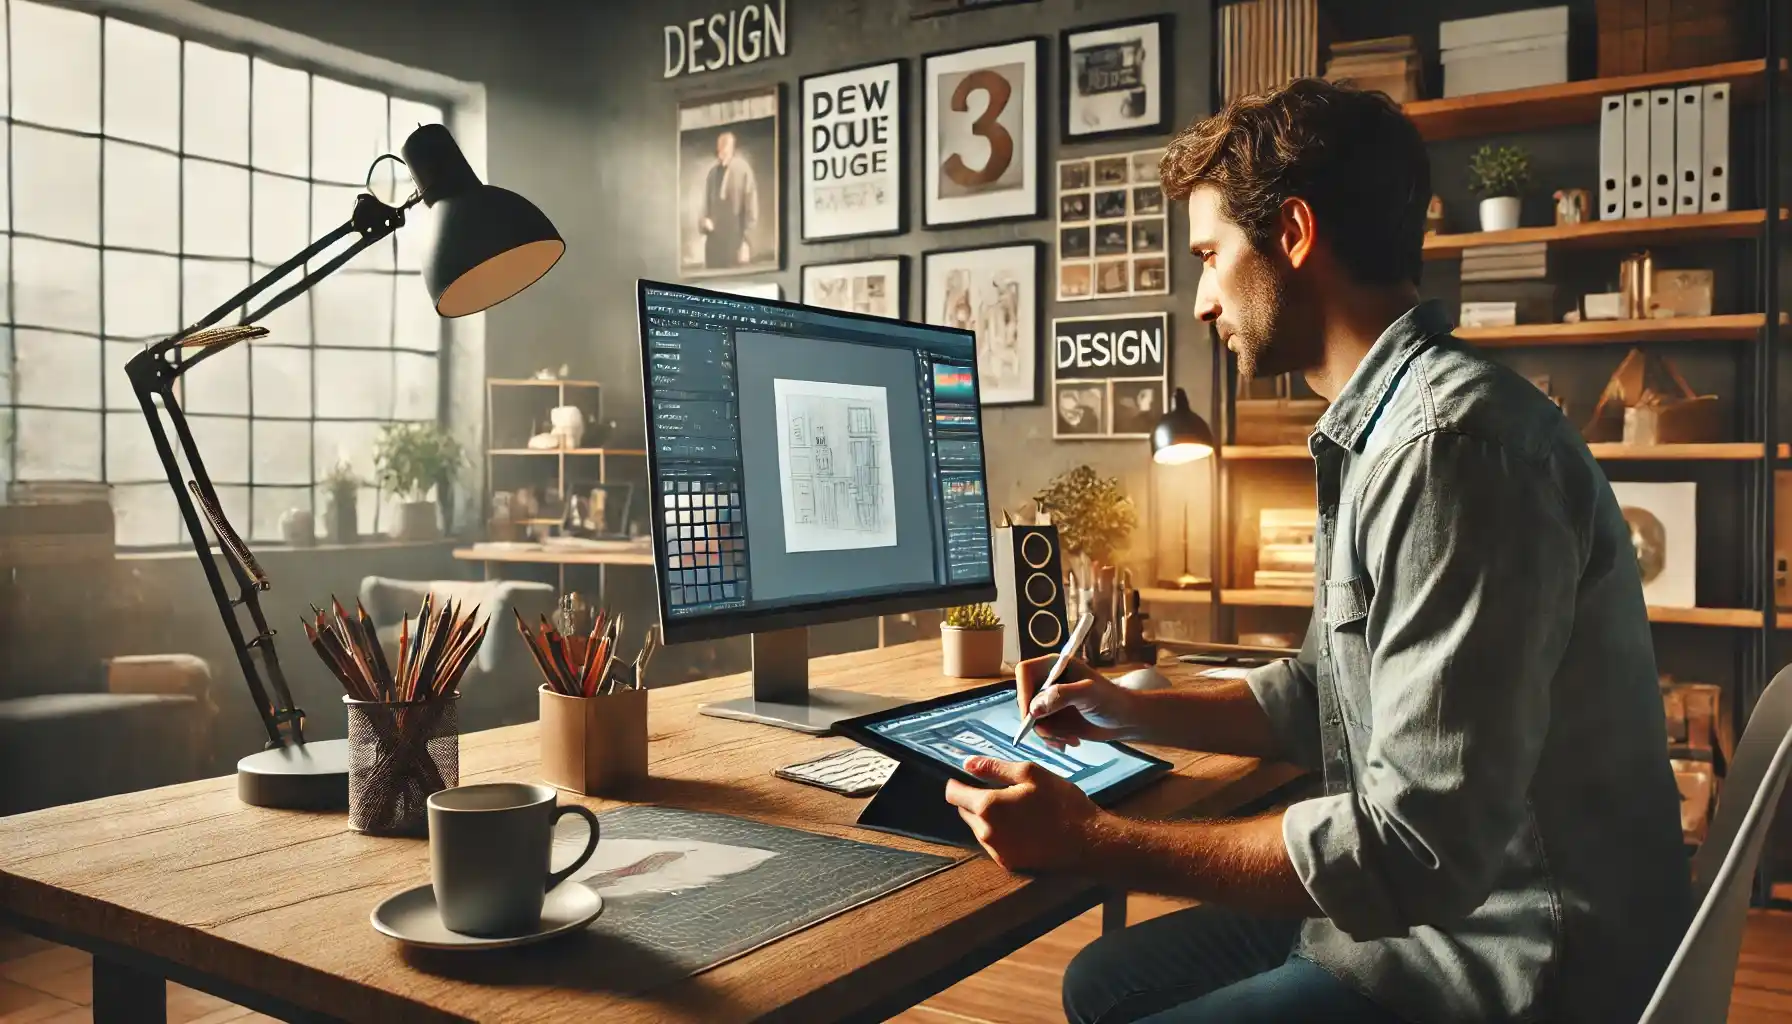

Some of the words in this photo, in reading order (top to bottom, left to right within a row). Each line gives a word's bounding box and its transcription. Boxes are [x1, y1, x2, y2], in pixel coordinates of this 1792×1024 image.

[664, 0, 787, 78] DESIGN
[812, 80, 890, 120] DEW
[942, 70, 1013, 187] 3
[812, 150, 888, 181] DUGE
[1056, 328, 1161, 369] DESIGN
